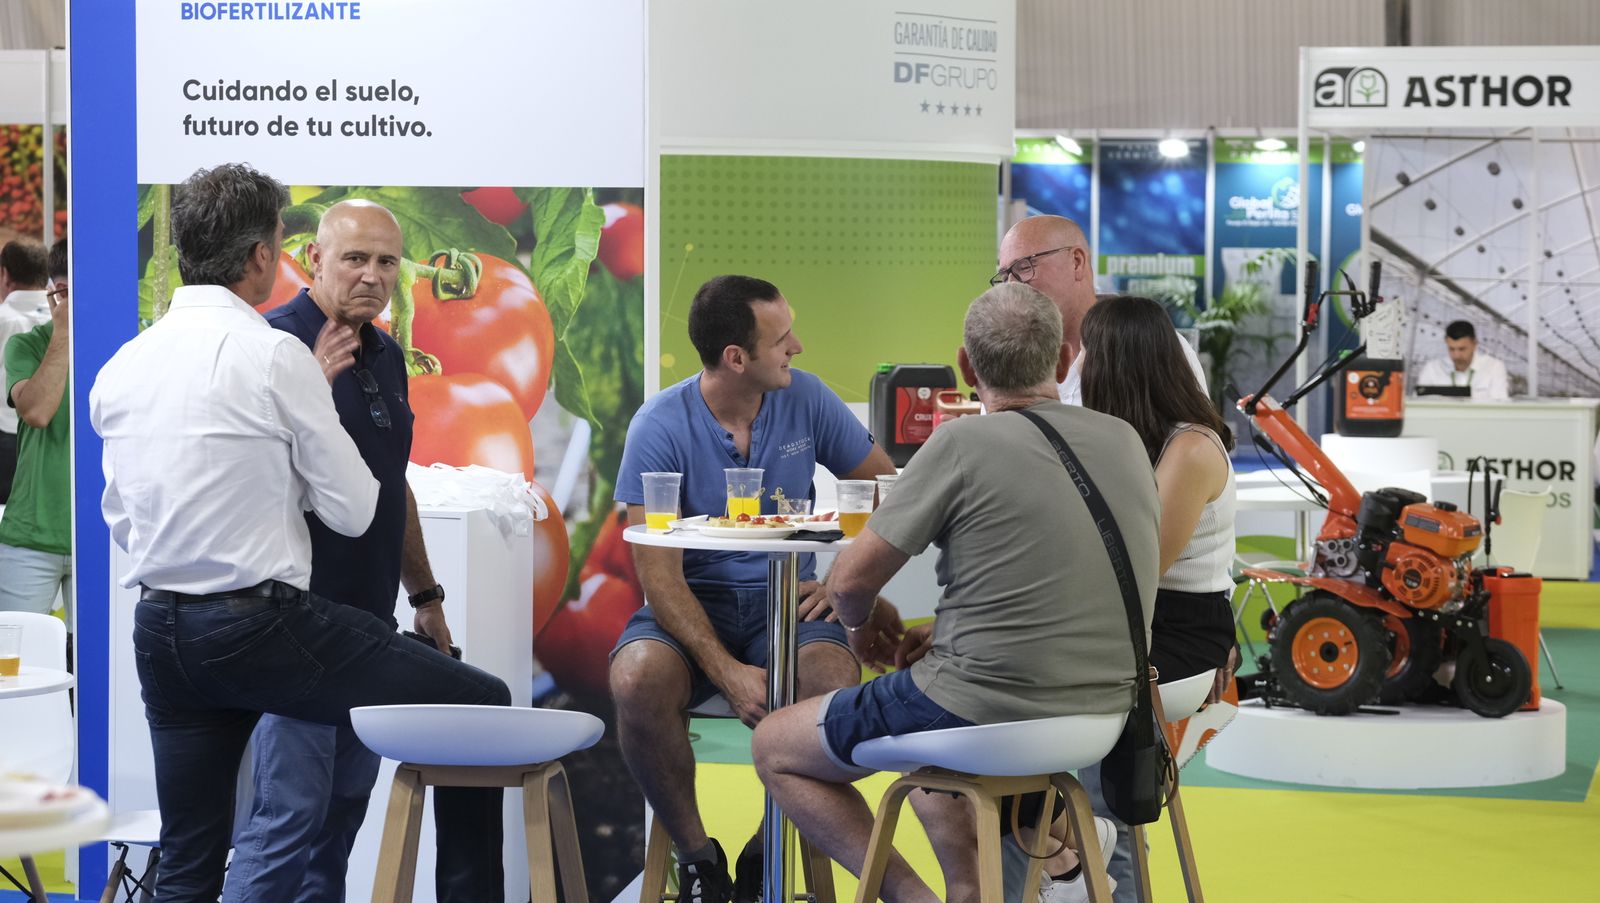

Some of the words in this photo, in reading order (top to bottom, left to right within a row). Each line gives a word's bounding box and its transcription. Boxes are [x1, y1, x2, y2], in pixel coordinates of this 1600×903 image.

[181, 2, 361, 20] BIOFERTILIZANTE
[894, 20, 949, 49] GARANTÍA
[951, 26, 964, 50] DE
[182, 79, 308, 101] Cuidando
[315, 79, 337, 101] el
[345, 79, 420, 106] suelo,
[1403, 75, 1573, 107] ASTHOR
[182, 114, 259, 136] futuro
[266, 115, 299, 136] de
[306, 117, 332, 136] tu
[340, 114, 433, 137] cultivo.
[1106, 252, 1195, 276] premium
[1051, 438, 1091, 499] BERTO
